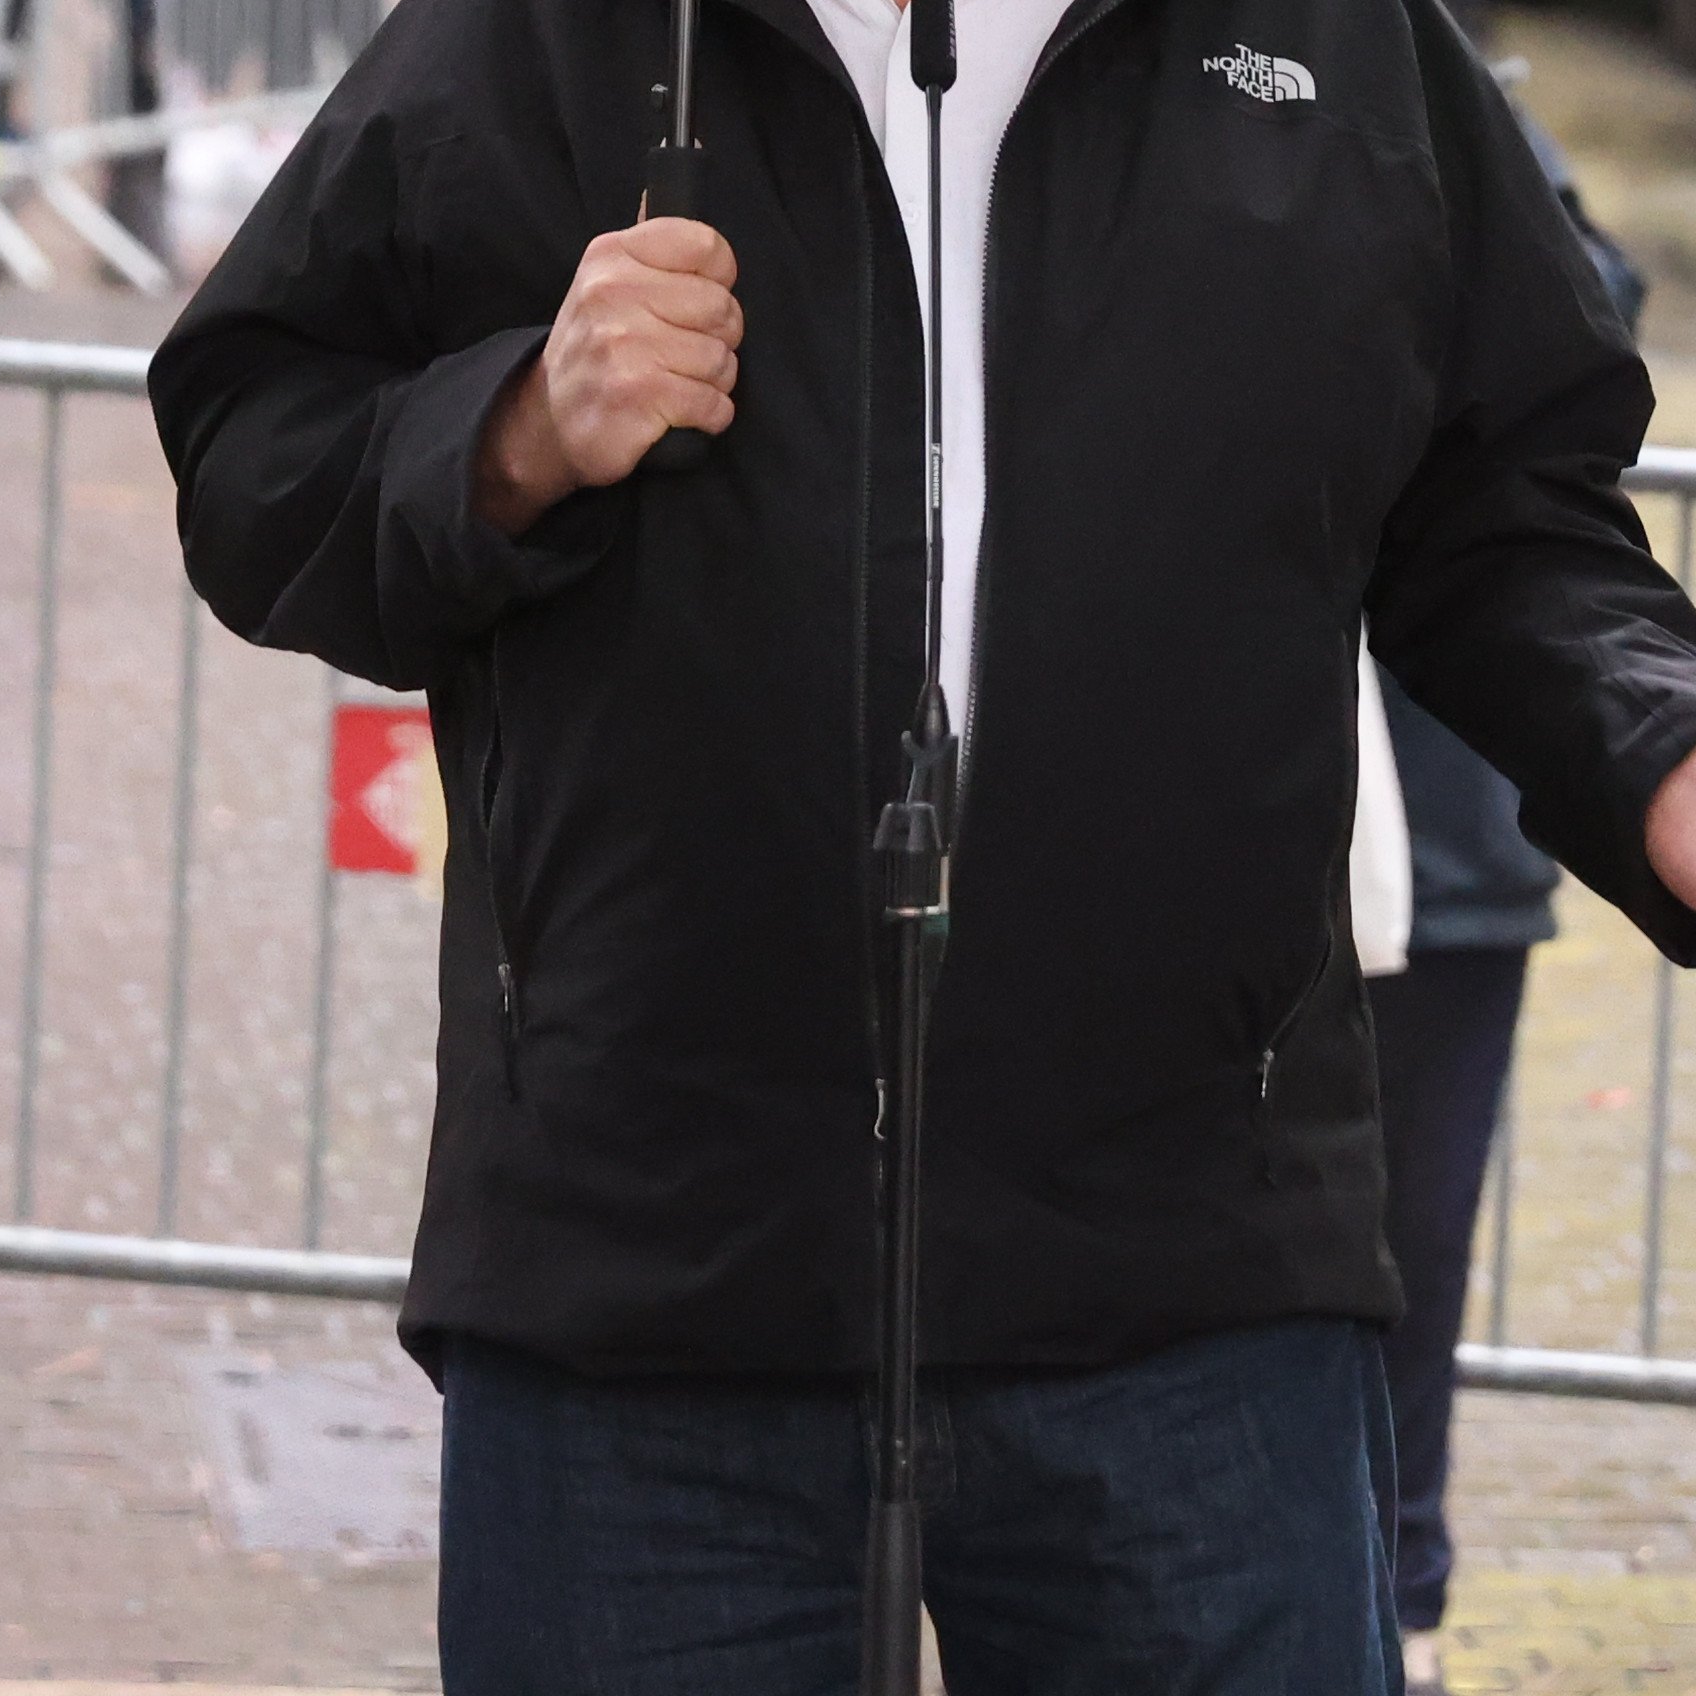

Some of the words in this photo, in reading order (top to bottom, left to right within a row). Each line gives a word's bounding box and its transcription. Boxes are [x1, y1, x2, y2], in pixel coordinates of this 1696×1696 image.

[1235, 43, 1272, 70] THE
[1203, 56, 1274, 89] NORTH
[1227, 71, 1274, 102] FACE
